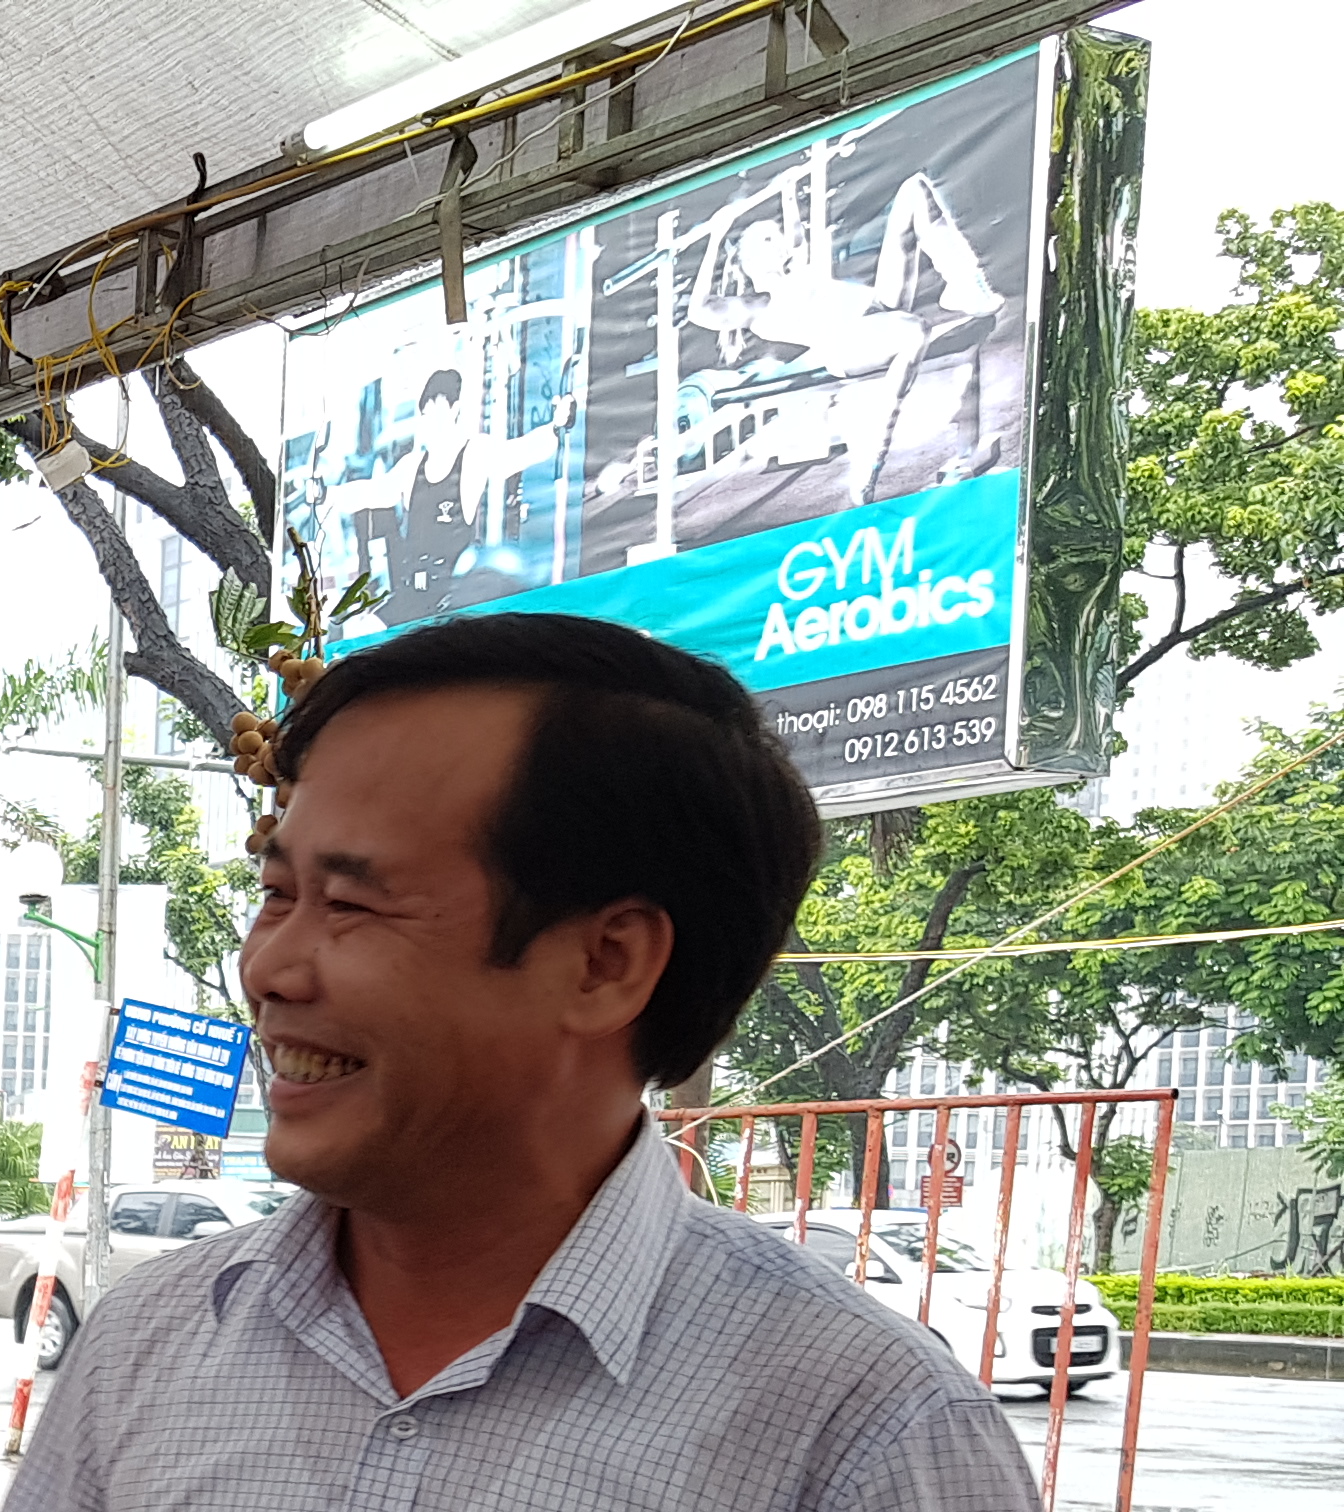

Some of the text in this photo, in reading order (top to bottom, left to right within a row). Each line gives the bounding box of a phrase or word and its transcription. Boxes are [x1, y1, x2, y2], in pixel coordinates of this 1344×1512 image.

[778, 516, 917, 601] GYM
[754, 569, 995, 662] Aerobics
[777, 674, 997, 735] thoại: 098 115 4562
[844, 717, 997, 763] 0912 613 539
